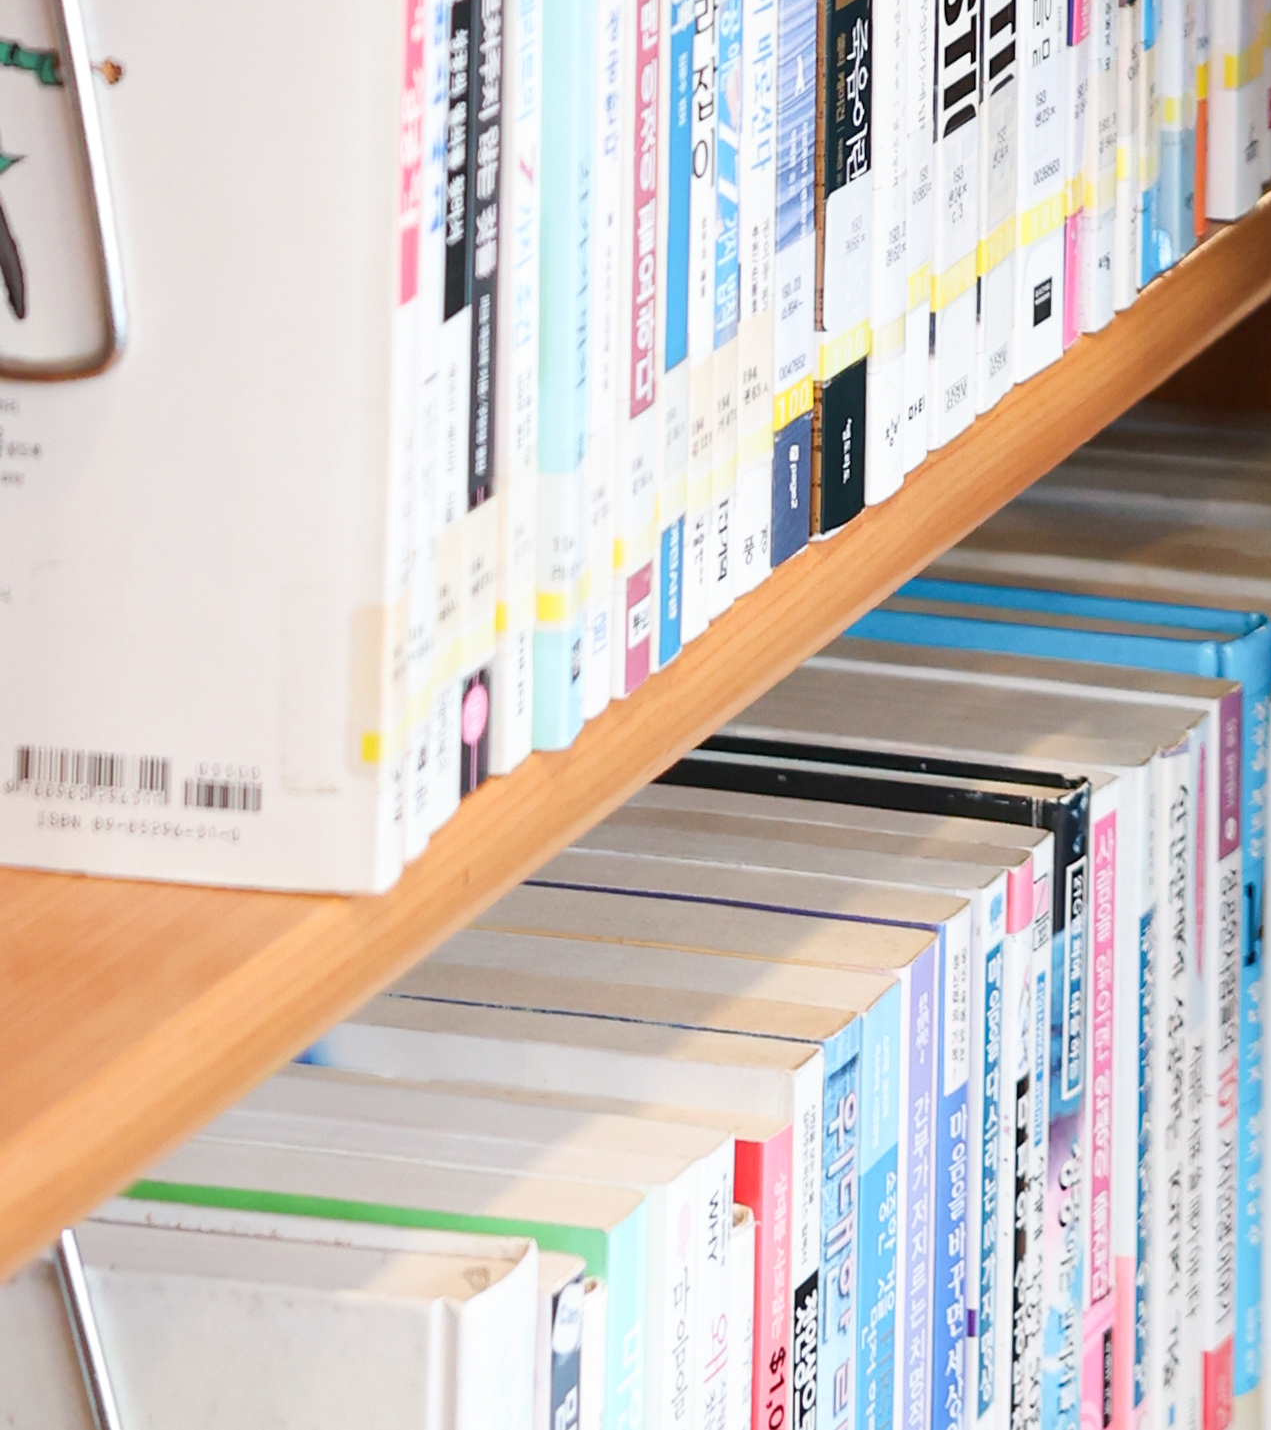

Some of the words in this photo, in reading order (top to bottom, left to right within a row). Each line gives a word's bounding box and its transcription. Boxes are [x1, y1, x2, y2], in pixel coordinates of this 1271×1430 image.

[750, 35, 775, 173] 바로선다
[846, 17, 869, 186] 죽음이란
[779, 378, 811, 422] 100
[914, 1092, 930, 1191] 간부가
[946, 1101, 969, 1220] 마음을
[707, 1188, 720, 1263] WHY
[822, 1089, 859, 1347] 위대한
[911, 1193, 928, 1327] 저지르는
[943, 1221, 966, 1337] 바꾸면
